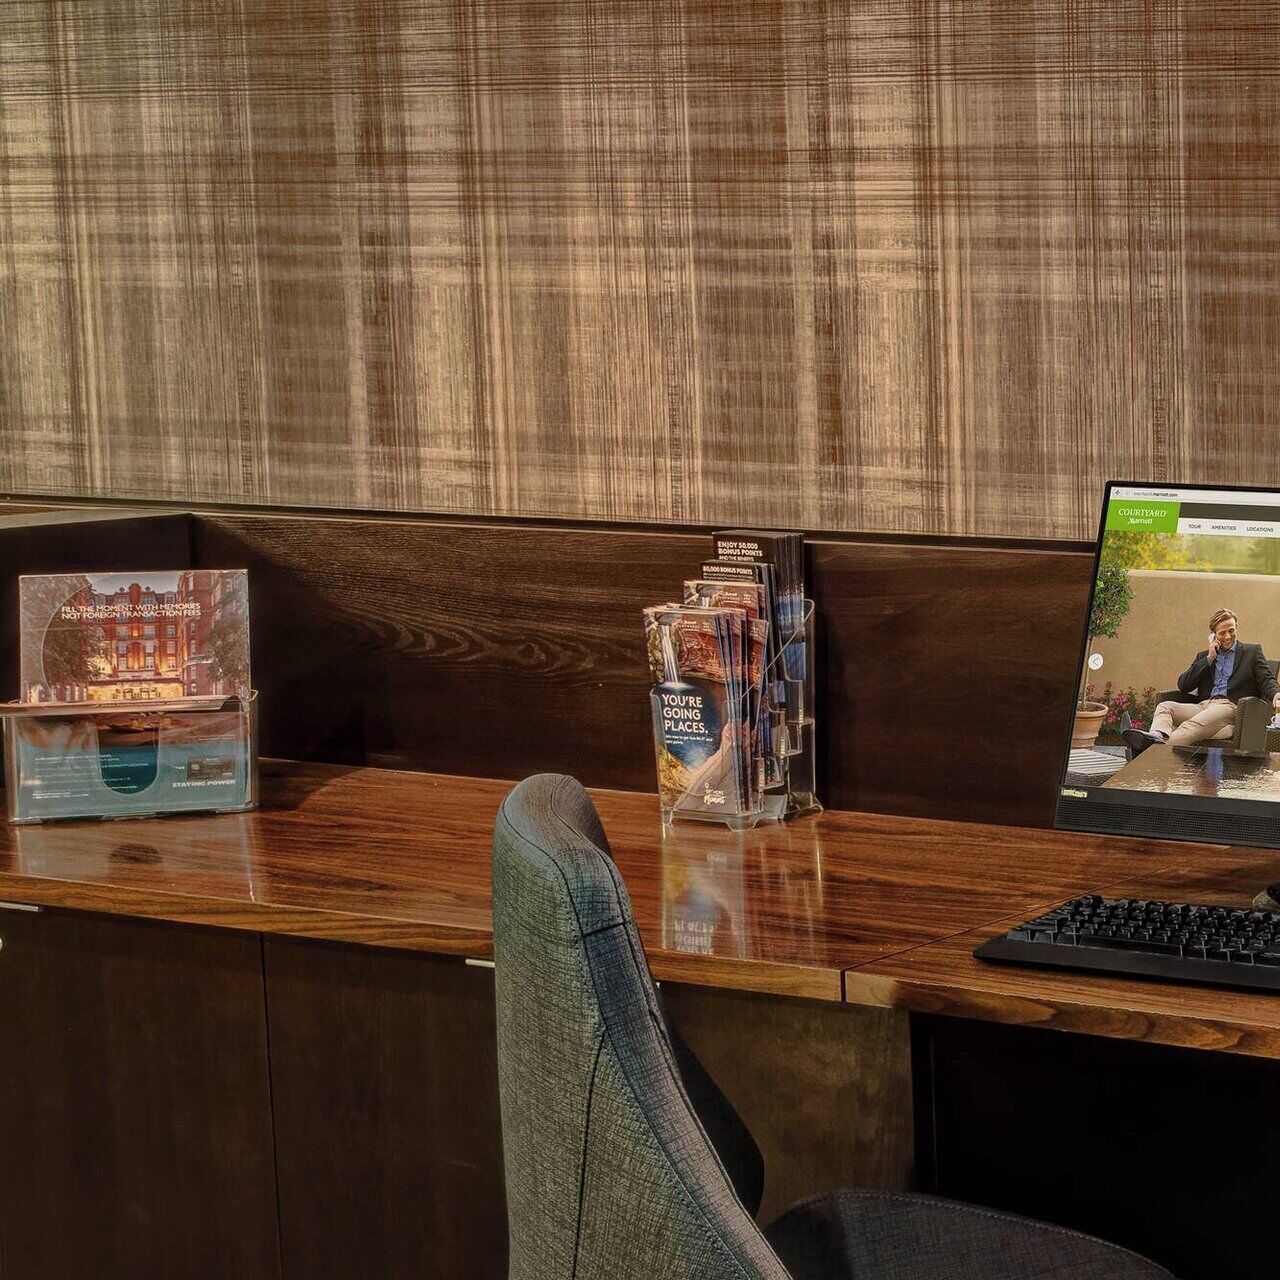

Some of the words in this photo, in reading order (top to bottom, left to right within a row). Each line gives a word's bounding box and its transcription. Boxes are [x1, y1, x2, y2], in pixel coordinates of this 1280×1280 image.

[1119, 508, 1167, 518] COURTYARD
[741, 549, 763, 557] POINTS
[79, 605, 95, 613] THE
[96, 604, 133, 612] MOMENT
[84, 611, 121, 619] FOREIGN
[122, 610, 182, 618] TRANSACTION
[662, 694, 703, 708] YOU'RE
[663, 707, 701, 720] GOING
[664, 720, 709, 734] PLACES.
